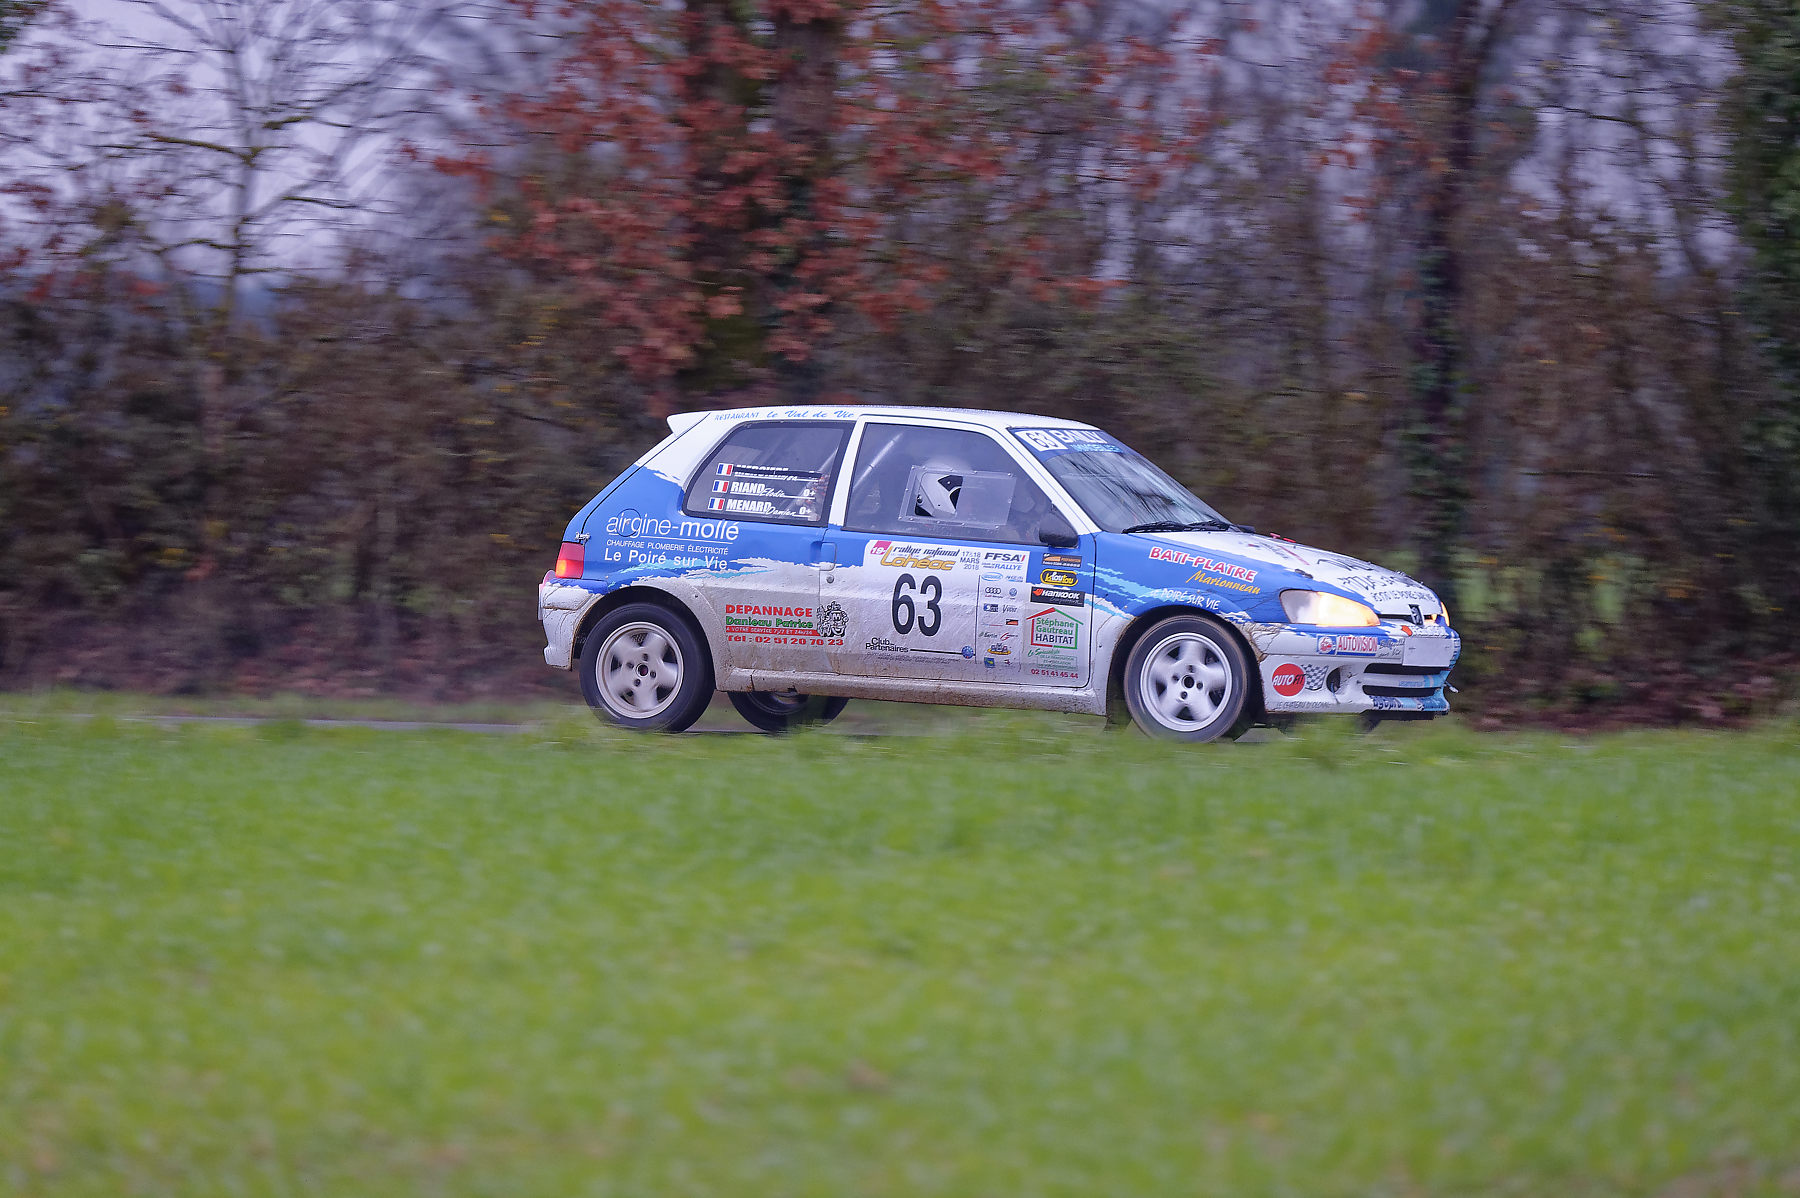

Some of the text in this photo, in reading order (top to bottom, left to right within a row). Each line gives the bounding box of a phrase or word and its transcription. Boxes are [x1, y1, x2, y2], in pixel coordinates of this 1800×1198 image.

[785, 410, 808, 418] Val
[834, 410, 854, 418] Vie
[731, 482, 766, 494] RIAND
[760, 488, 786, 498] Elodie
[727, 499, 772, 512] MENARD
[766, 506, 796, 515] Damien
[606, 512, 740, 541] airgine-mollé
[606, 539, 729, 556] CHAUFFAGE PLOMBERIE ÉLECTRICITÉ
[923, 547, 960, 558] national
[604, 548, 728, 569] Le Poiré sur Vie
[960, 557, 981, 565] MARS
[984, 552, 1020, 562] FFSA
[1149, 546, 1258, 583] BATI-PLATRE
[1185, 570, 1261, 595] Marionneau
[891, 572, 943, 637] 63
[1186, 594, 1205, 607] SUR
[1205, 598, 1221, 610] VIE
[725, 604, 813, 617] DEPANNAGE
[775, 617, 814, 629] Patrice
[1036, 617, 1075, 630] Stéphane
[1036, 625, 1073, 636] Gautreau
[791, 637, 807, 645] 20
[871, 637, 891, 646] Club
[1035, 633, 1075, 645] HABITAT
[1336, 636, 1379, 653] AUTOVISION
[1272, 673, 1307, 686] AUTOFIT
